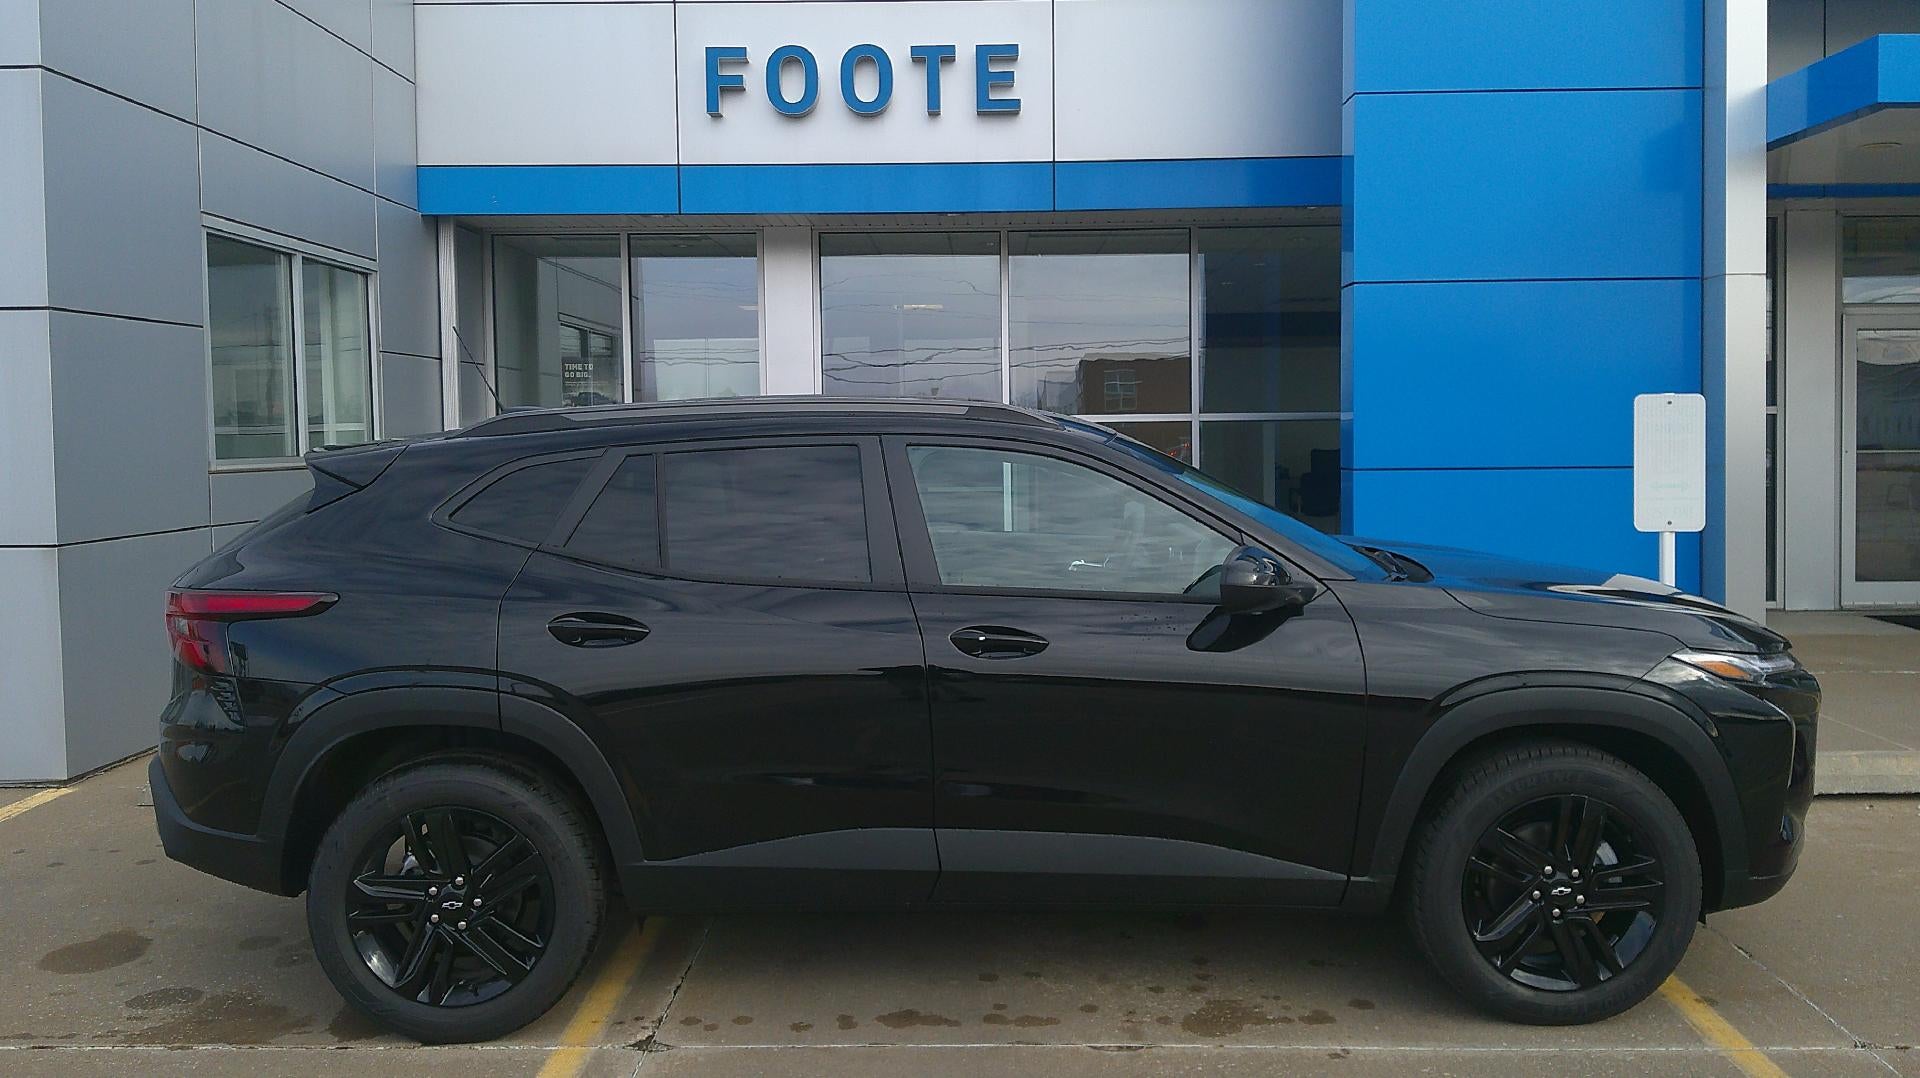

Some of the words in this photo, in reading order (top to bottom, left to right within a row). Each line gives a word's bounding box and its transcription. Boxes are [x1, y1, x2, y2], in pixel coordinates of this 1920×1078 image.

[705, 44, 1021, 117] FOOTE
[564, 363, 583, 371] TIME
[584, 363, 593, 371] TO
